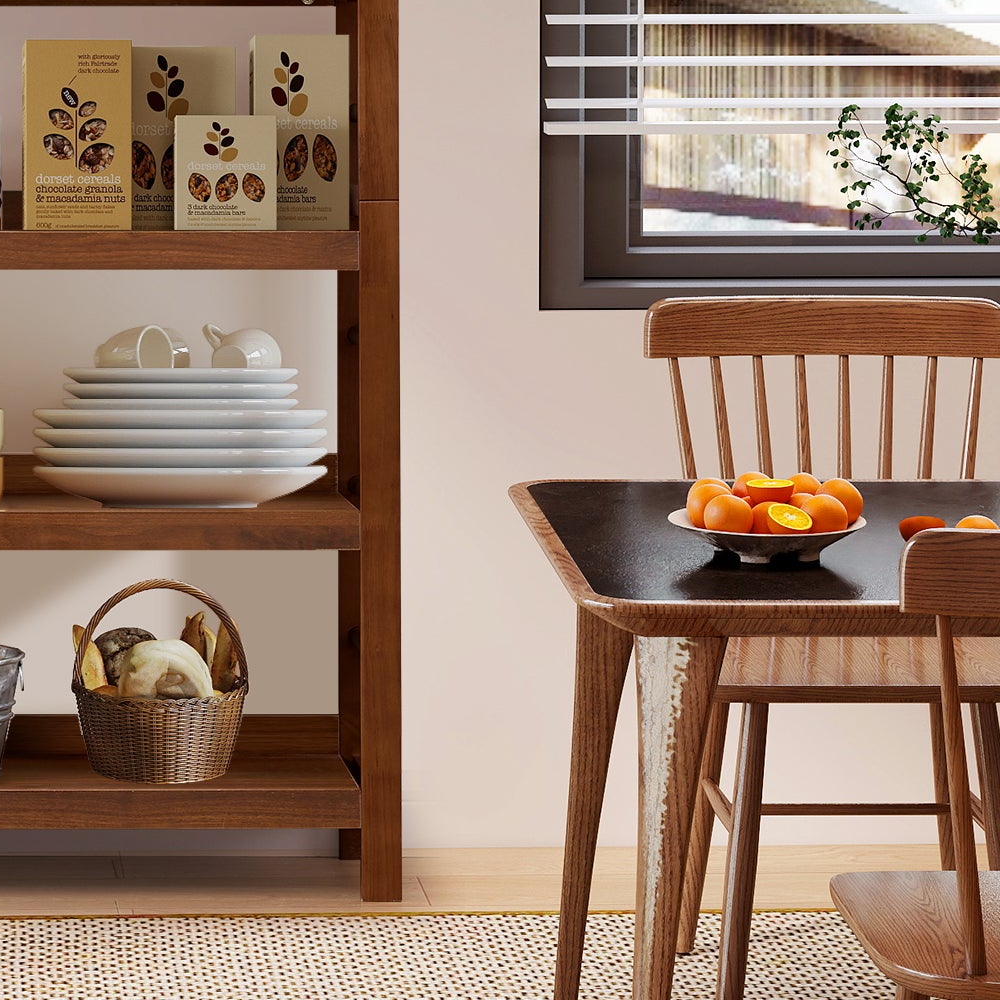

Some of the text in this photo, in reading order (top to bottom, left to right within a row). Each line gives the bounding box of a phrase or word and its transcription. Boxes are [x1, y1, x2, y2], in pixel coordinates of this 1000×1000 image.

[63, 89, 77, 106] new
[295, 115, 338, 130] cereals
[35, 173, 121, 185] dorset cereals
[35, 184, 124, 195] chocolate granola
[35, 194, 126, 204] & macadamia nuts
[133, 193, 152, 203] dark
[301, 195, 317, 204] bars
